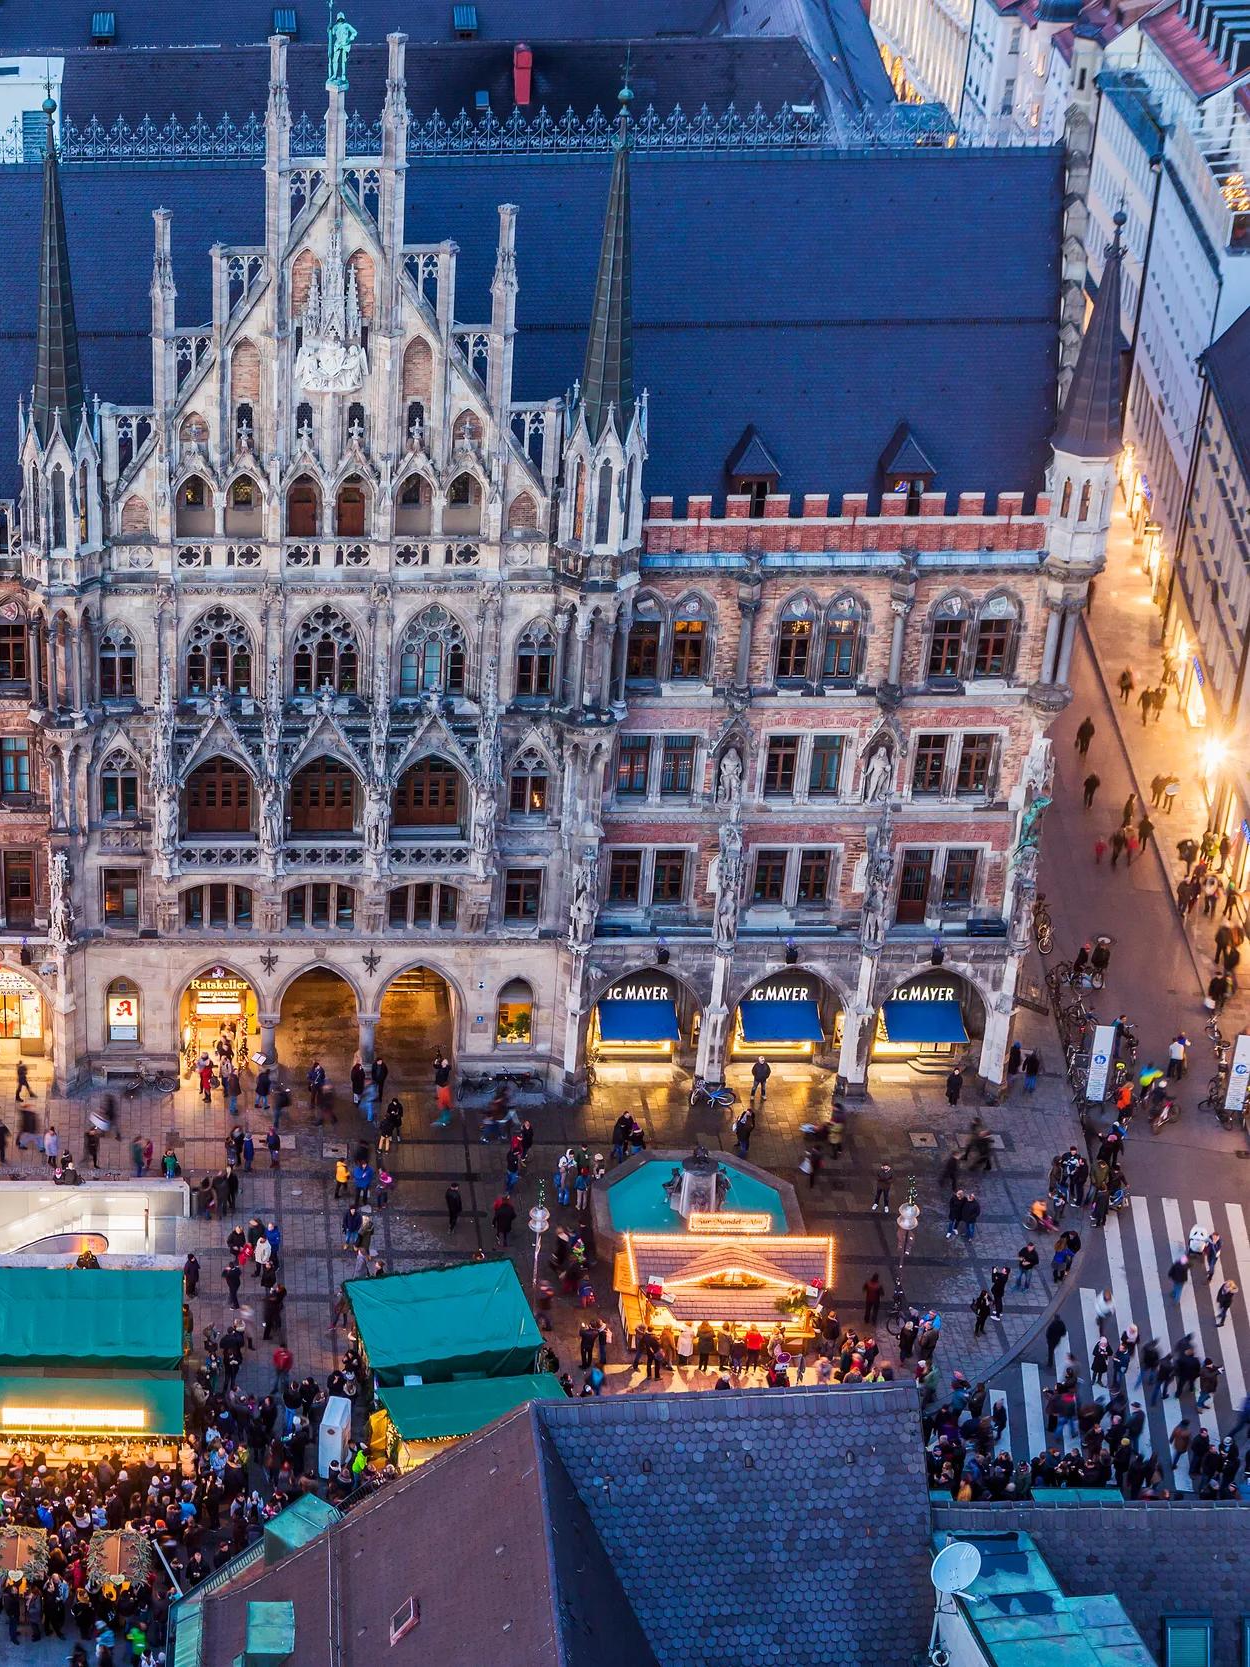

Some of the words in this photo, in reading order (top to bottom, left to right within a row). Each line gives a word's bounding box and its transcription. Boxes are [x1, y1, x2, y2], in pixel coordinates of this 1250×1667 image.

[190, 980, 249, 990] Ratskeller
[624, 985, 668, 1000] MAYER
[765, 986, 809, 1001] MAYER
[909, 986, 954, 1001] MAYER
